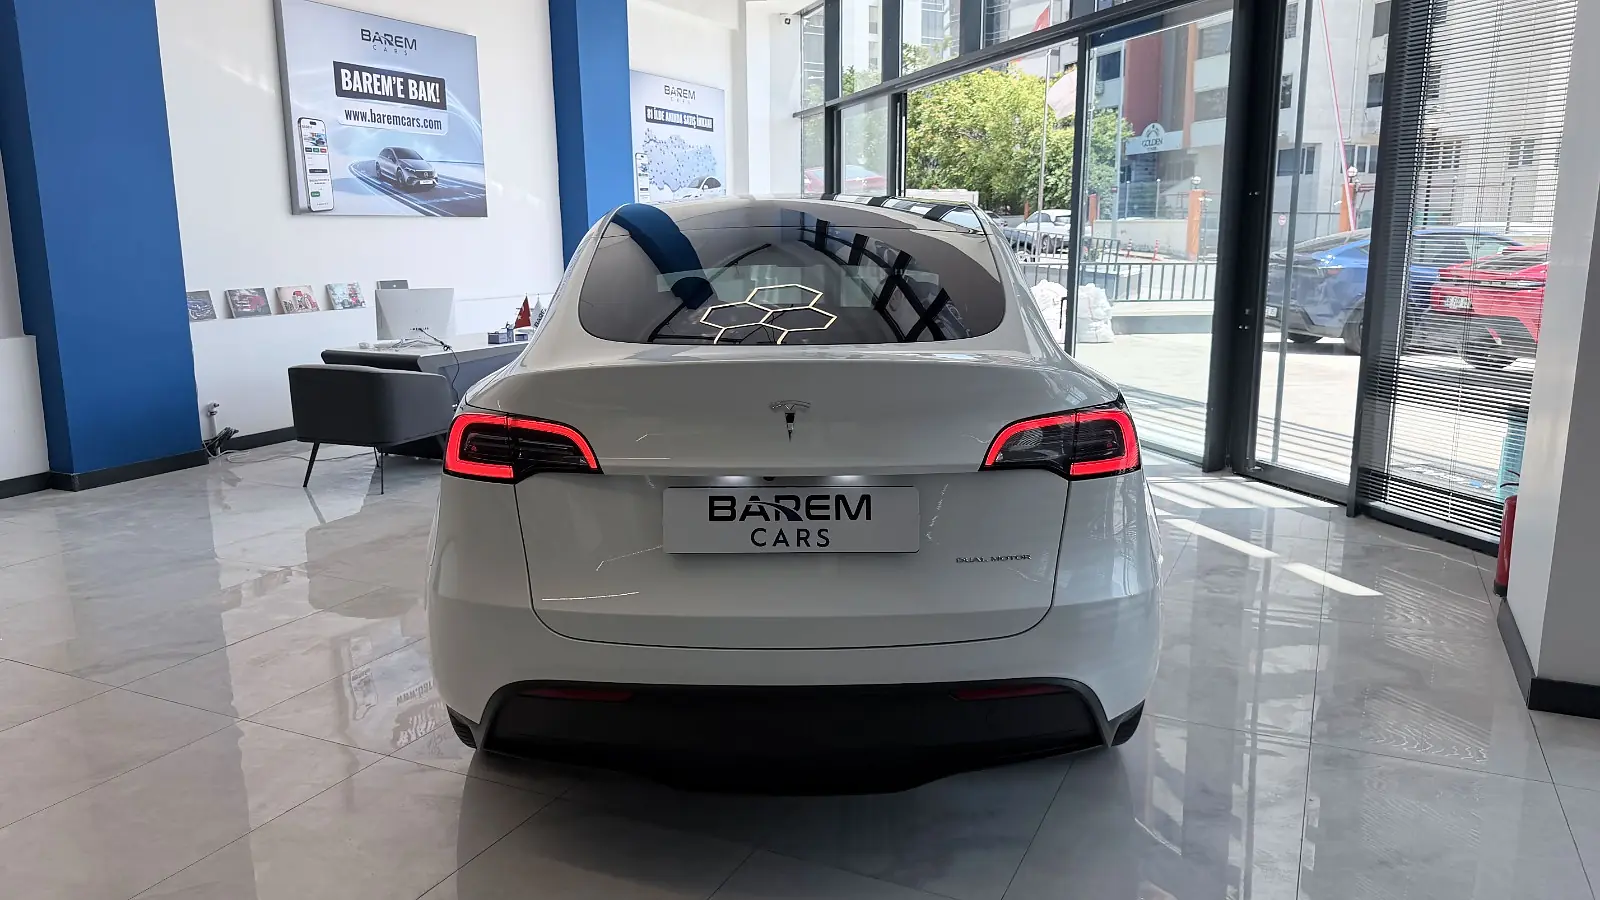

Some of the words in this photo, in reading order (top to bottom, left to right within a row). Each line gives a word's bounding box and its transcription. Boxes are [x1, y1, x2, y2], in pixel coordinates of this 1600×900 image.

[360, 28, 417, 51] BAREM
[407, 78, 440, 103] BAK!
[664, 84, 696, 100] BAREM
[344, 108, 442, 130] www.baremcars.com
[708, 494, 872, 522] BAREM
[750, 527, 830, 548] CARS
[955, 556, 988, 564] DUAL
[990, 554, 1032, 563] MOTOR
